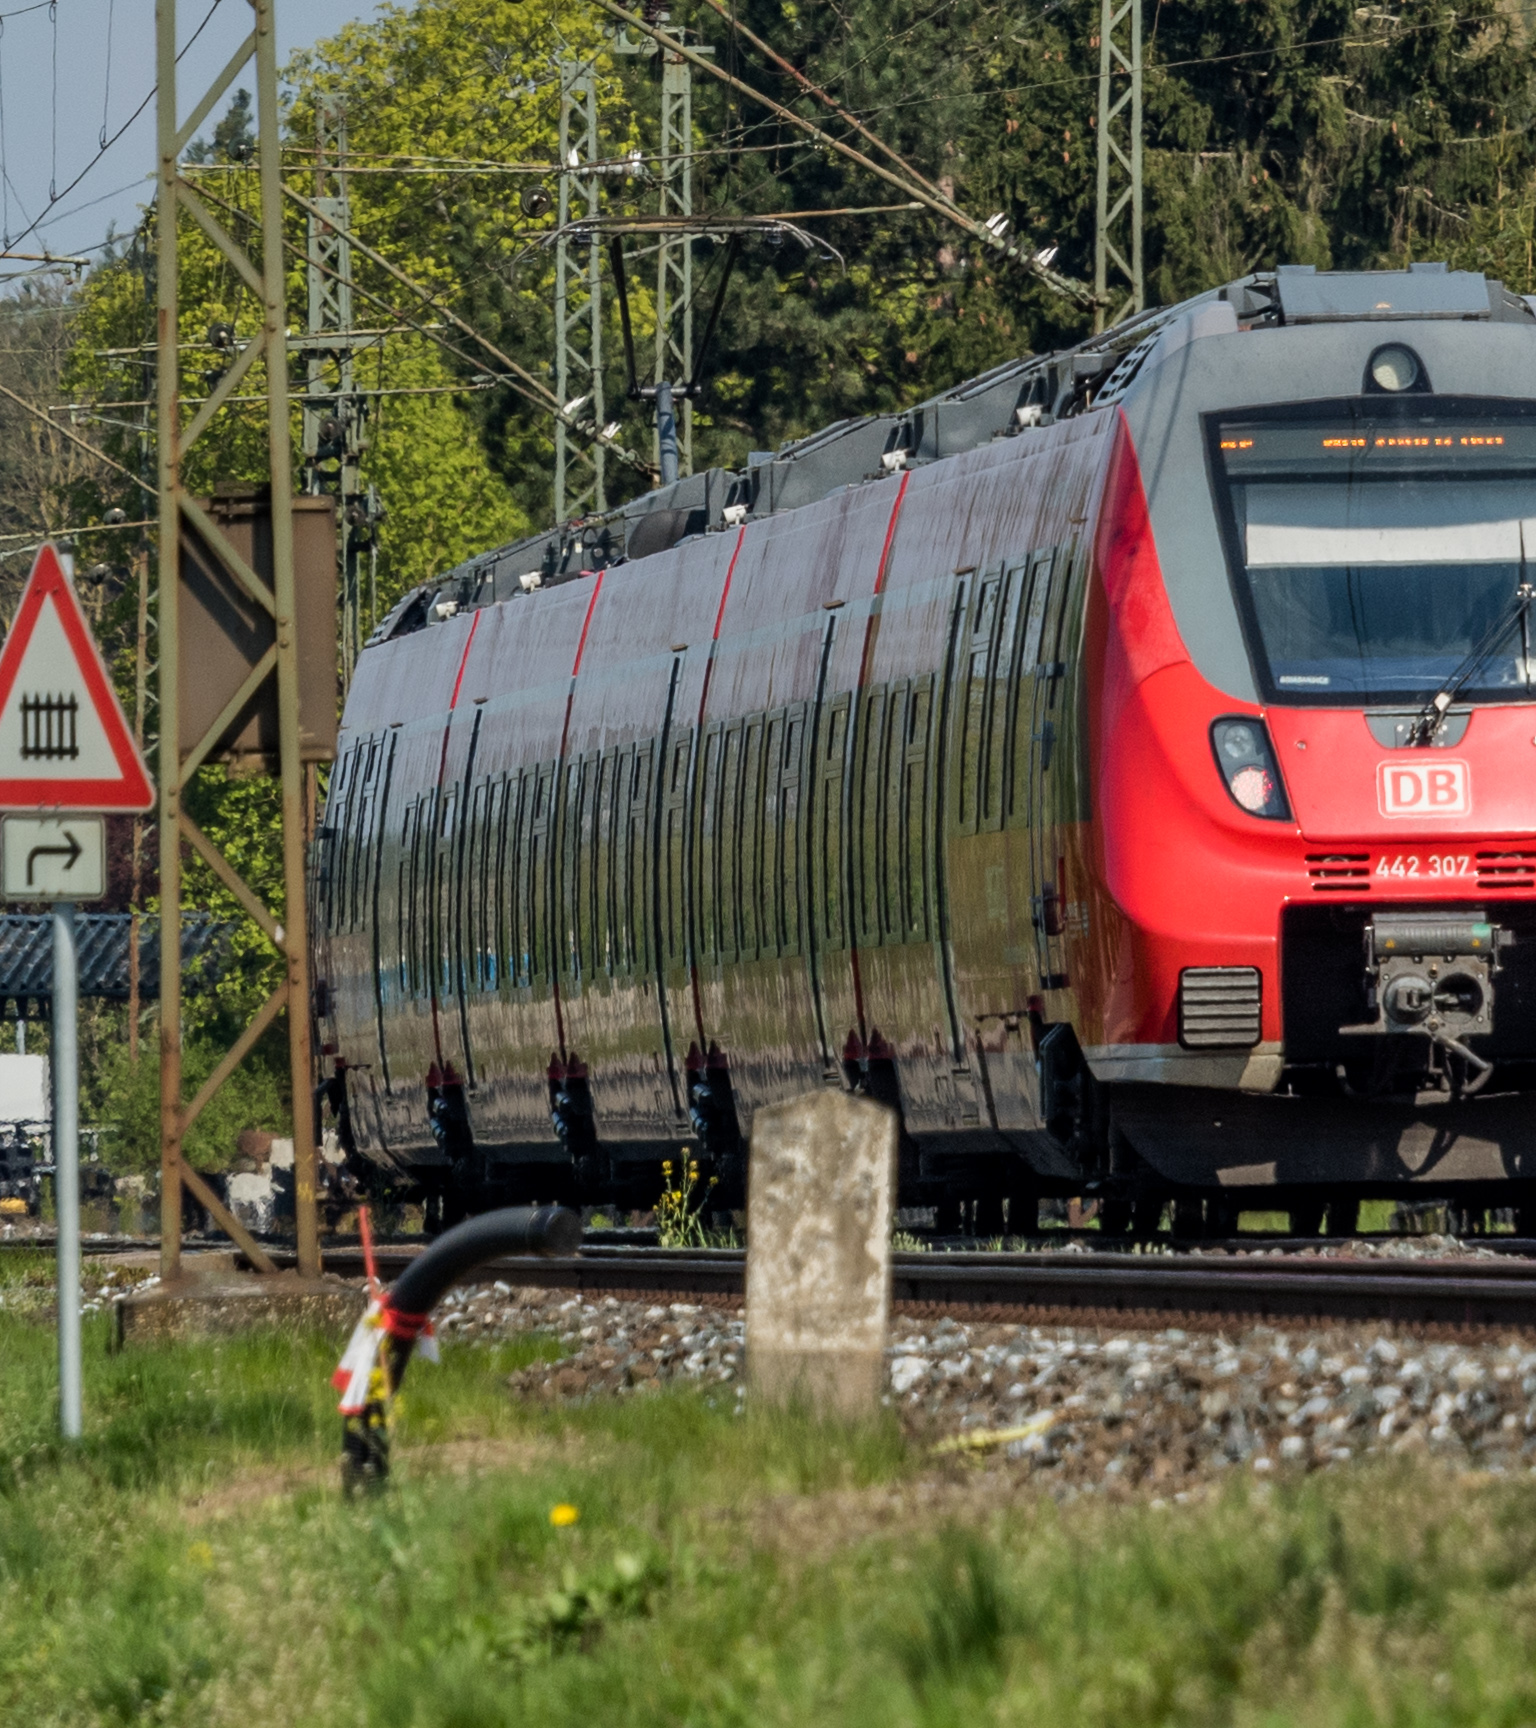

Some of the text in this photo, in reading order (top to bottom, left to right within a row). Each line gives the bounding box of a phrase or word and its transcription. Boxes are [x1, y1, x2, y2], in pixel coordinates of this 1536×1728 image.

[1390, 769, 1458, 808] DB
[1375, 855, 1470, 878] 442 307
